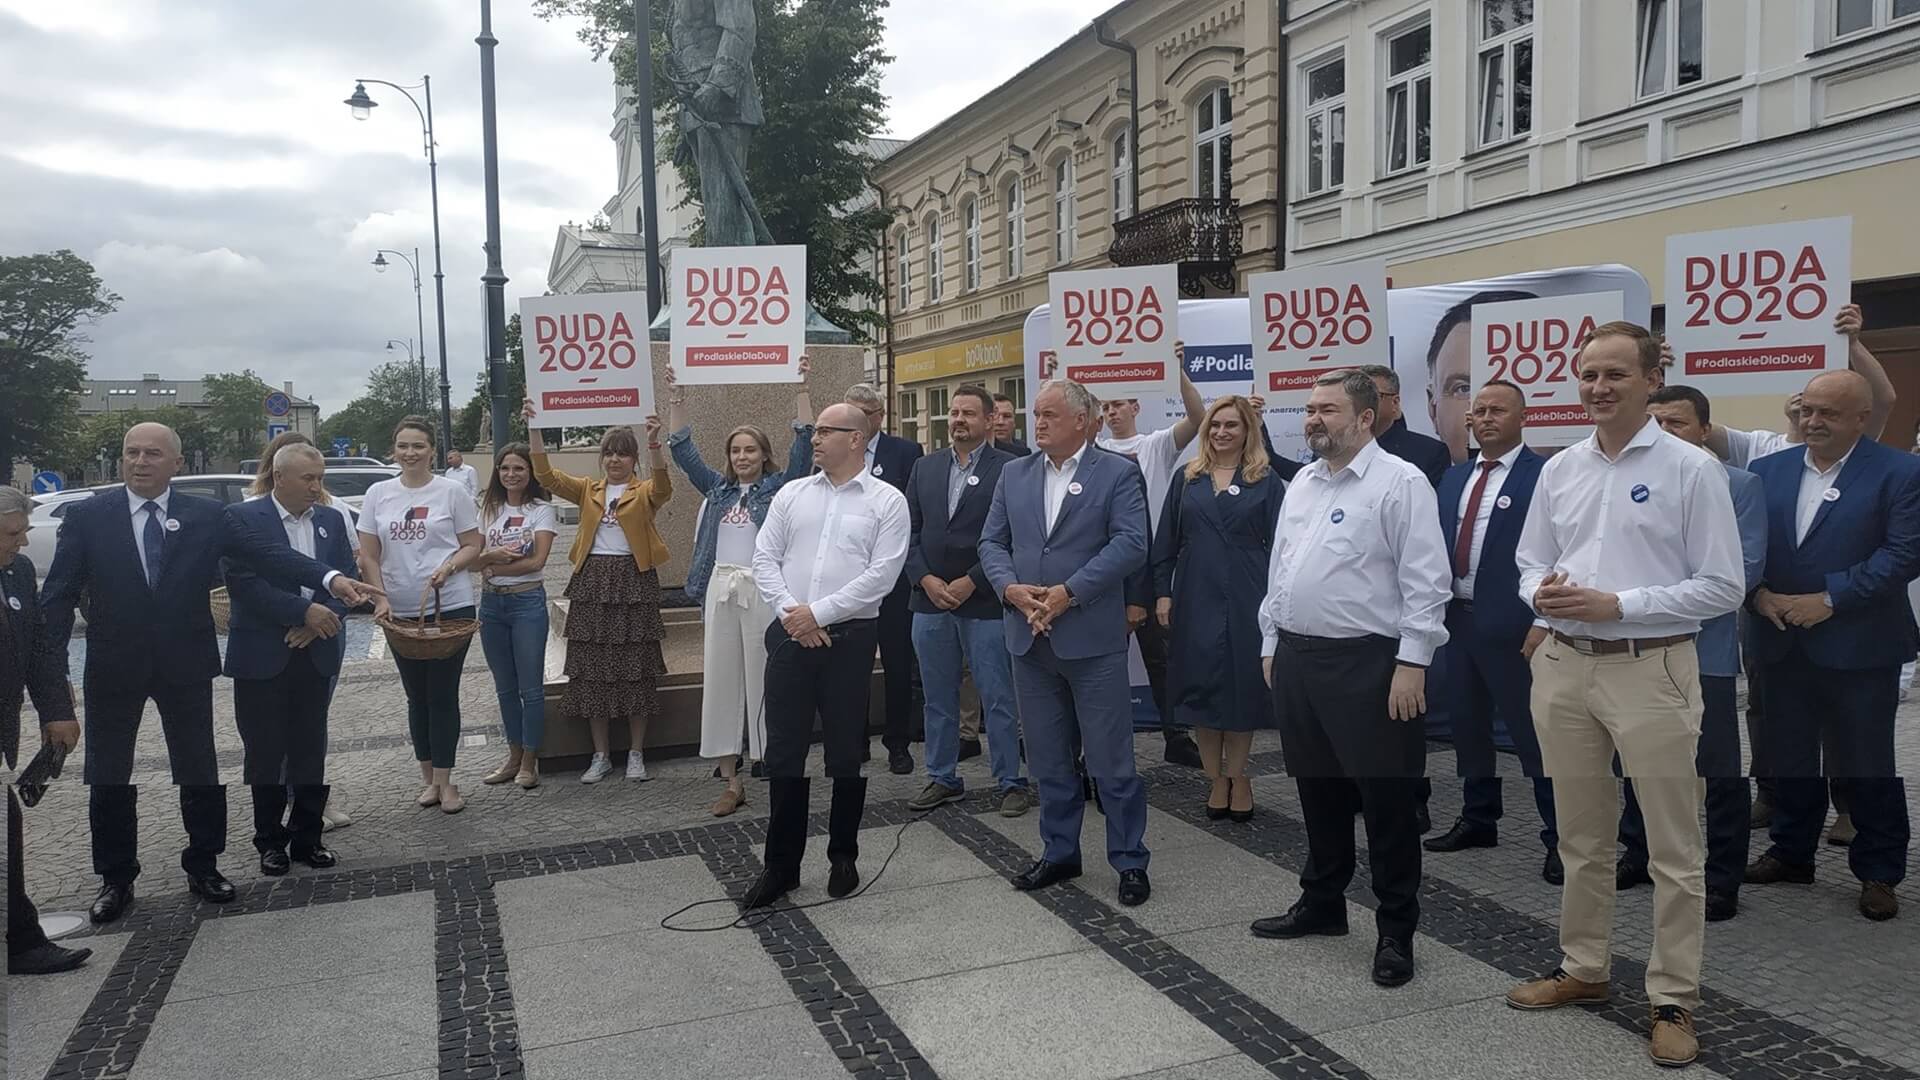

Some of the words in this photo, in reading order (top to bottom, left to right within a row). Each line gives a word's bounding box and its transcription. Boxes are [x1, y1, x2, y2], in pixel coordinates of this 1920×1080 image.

[687, 266, 789, 297] DUDA
[1686, 246, 1826, 292] DUDA
[686, 296, 790, 326] 2020
[1064, 286, 1162, 319] DUDA
[1264, 284, 1370, 322] DUDA
[1685, 283, 1827, 327] 2020
[536, 312, 633, 344] DUDA
[1066, 314, 1163, 346] 2020
[1267, 314, 1372, 351] 2020
[1487, 316, 1597, 355] DUDA
[539, 341, 636, 372] 2020
[693, 350, 782, 362] #PodlaskieDlaDudy
[1189, 354, 1254, 373] #Podla
[1694, 352, 1815, 369] #PodlaskieDlaDudy
[1073, 367, 1158, 379] #PodlaskieDlaDudy
[549, 394, 632, 406] #PodlaskieDlaDudy
[390, 521, 426, 531] DUDA
[390, 530, 426, 541] 2020
